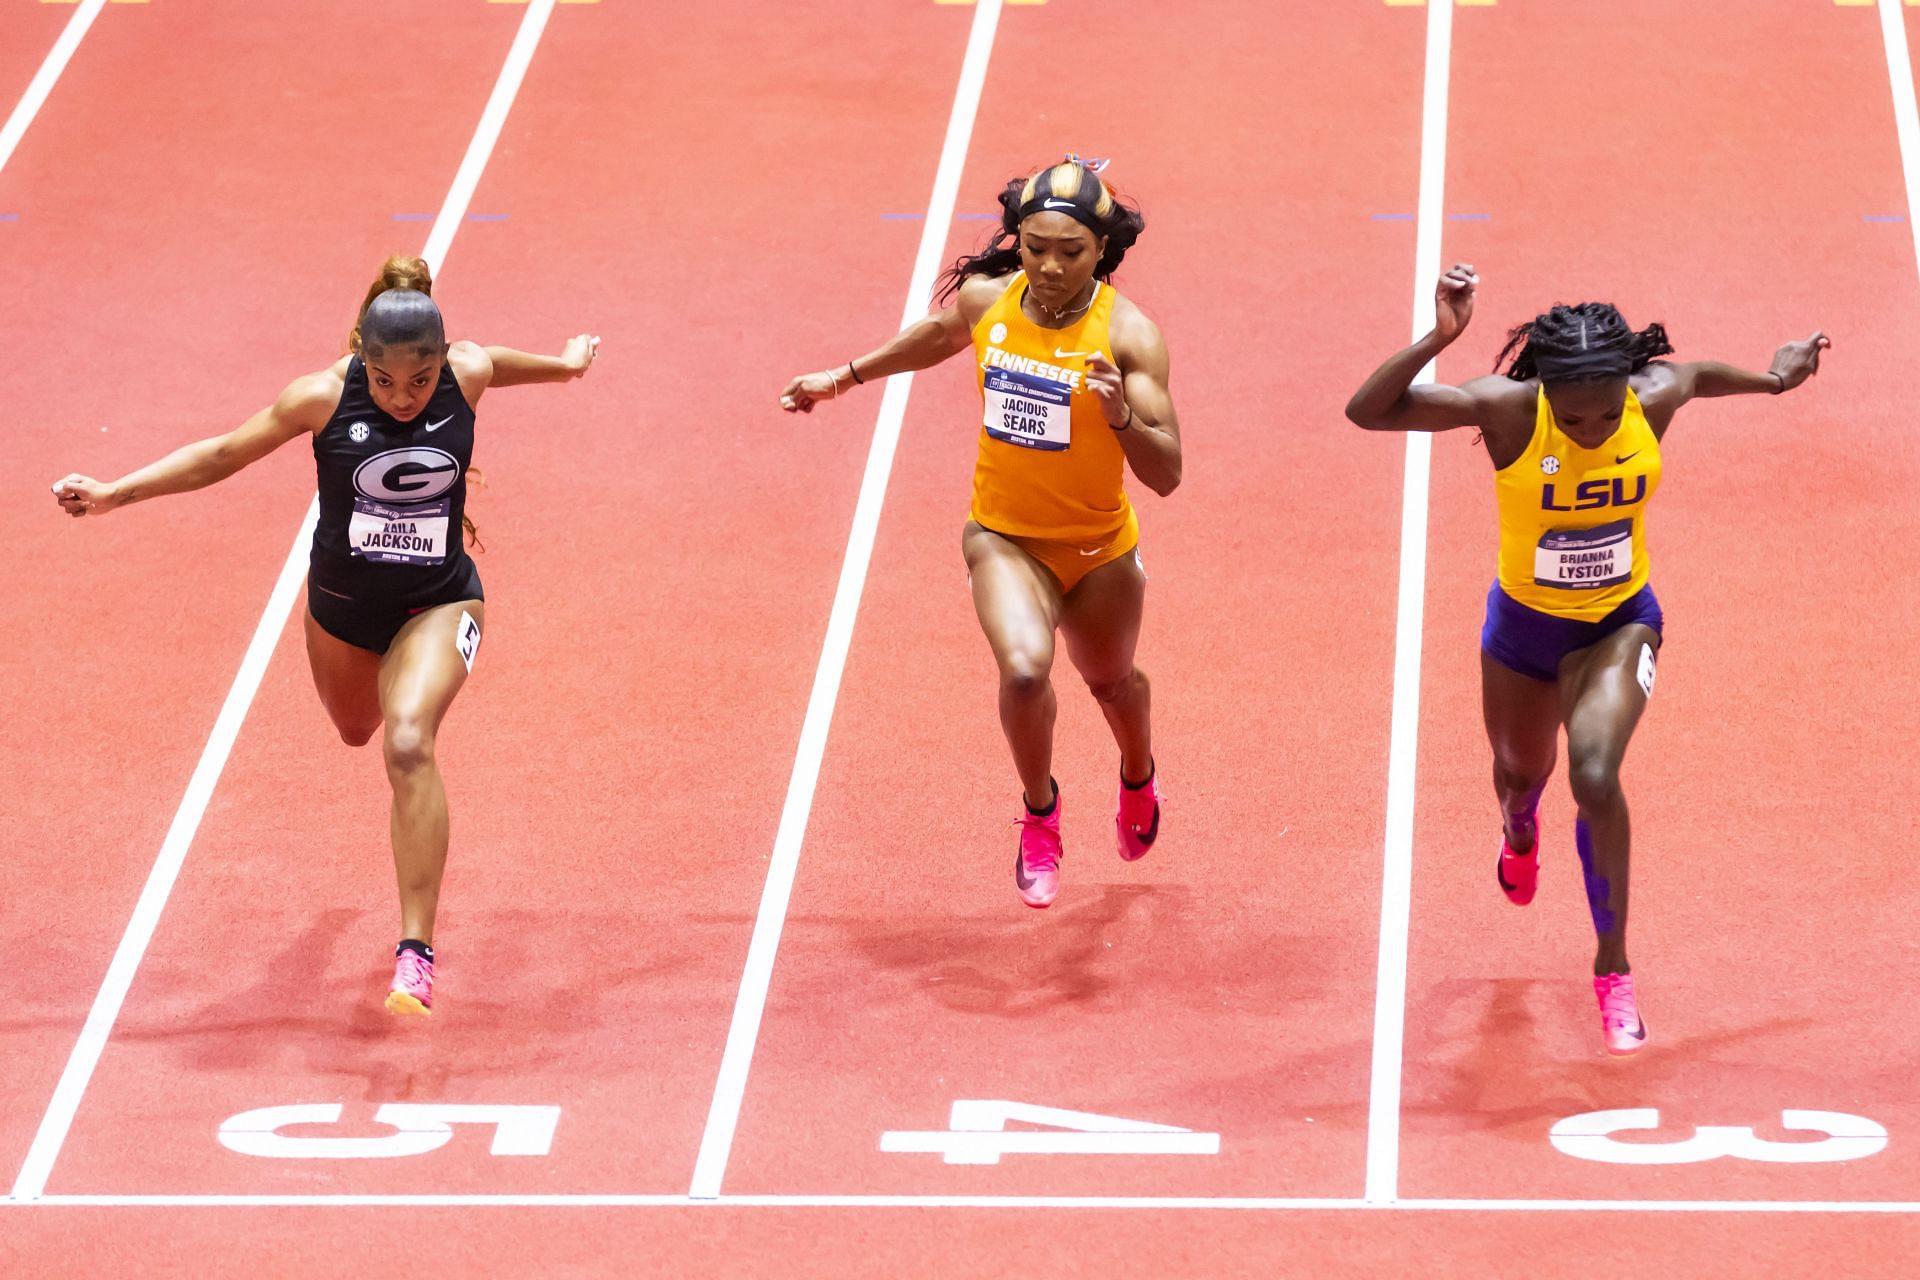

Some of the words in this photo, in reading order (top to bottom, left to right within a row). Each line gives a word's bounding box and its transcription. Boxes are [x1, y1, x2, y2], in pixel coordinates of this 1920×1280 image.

[984, 346, 1083, 388] TENNESSEE
[1002, 398, 1048, 418] JACIOUS
[349, 422, 369, 442] SEC
[1003, 413, 1046, 436] SEARS
[357, 449, 457, 501] G
[1541, 474, 1647, 511] LSU
[362, 533, 433, 552] JACKSON
[383, 522, 417, 534] KAILA
[1559, 563, 1614, 579] LYSTON
[1560, 549, 1614, 564] BRIANNA
[462, 620, 478, 661] 5
[217, 1103, 561, 1158] 5
[879, 1100, 1221, 1164] 4
[1550, 1108, 1887, 1164] 3
